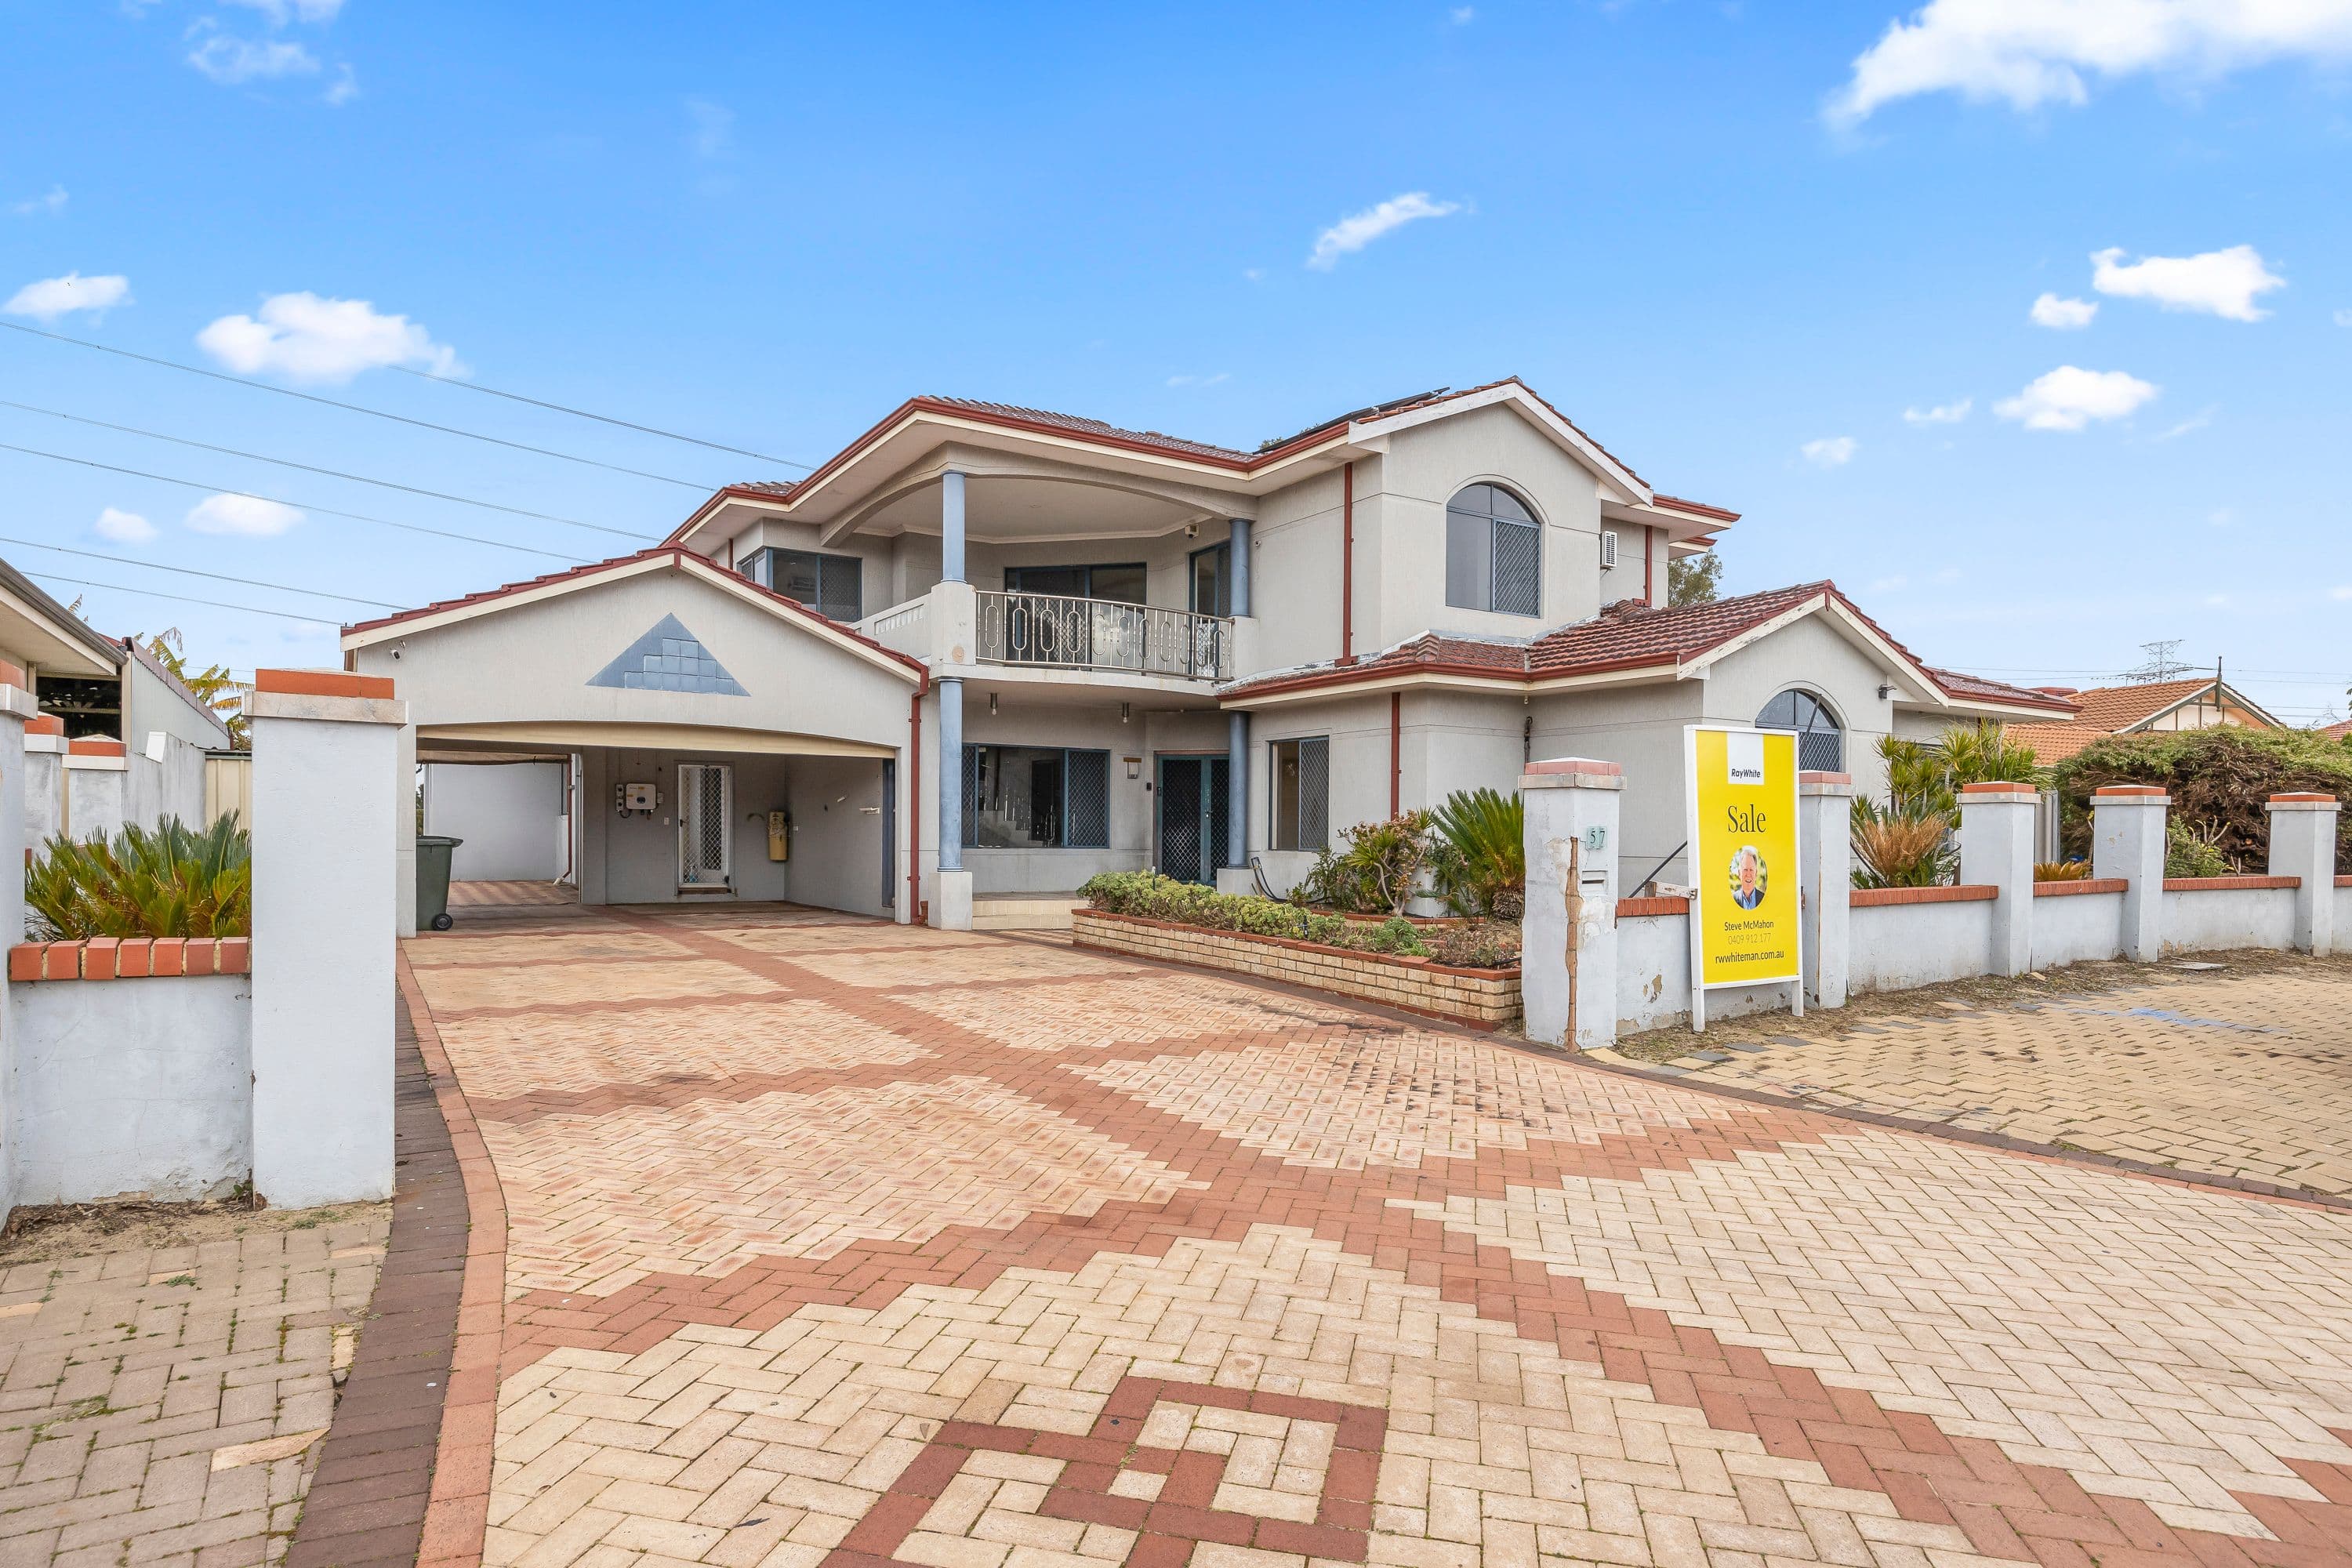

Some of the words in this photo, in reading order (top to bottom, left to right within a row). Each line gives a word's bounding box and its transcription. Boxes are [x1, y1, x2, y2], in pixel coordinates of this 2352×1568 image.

[1728, 804, 1766, 833] Sale
[1590, 830, 1606, 844] 57
[1724, 921, 1742, 931] Steve
[1743, 920, 1774, 930] McMahon
[1715, 950, 1784, 964] rwwhiteman.com.au
